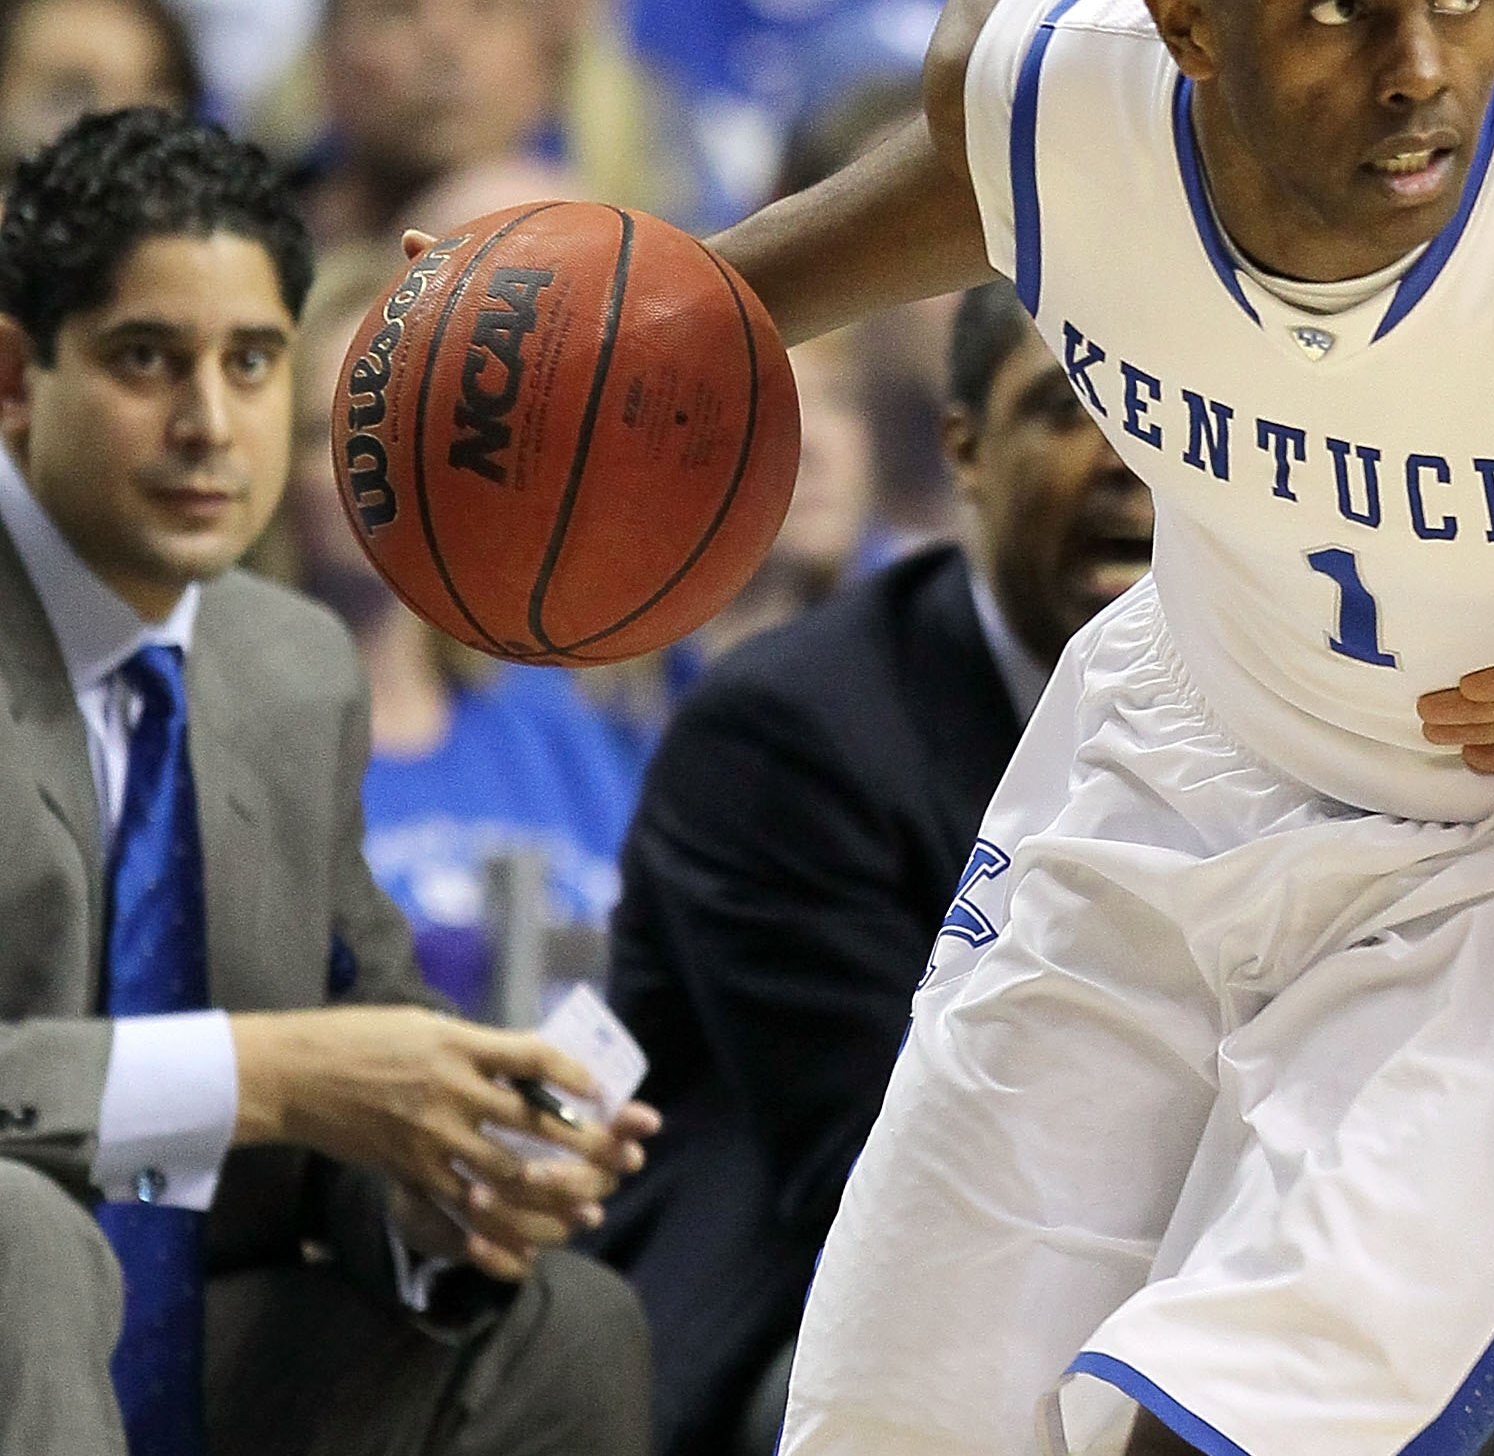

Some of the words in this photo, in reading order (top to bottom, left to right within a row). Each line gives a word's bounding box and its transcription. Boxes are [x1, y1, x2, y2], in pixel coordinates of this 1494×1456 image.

[346, 232, 472, 539] Wilson
[447, 265, 556, 488] NCAA
[1304, 546, 1399, 669] 1
